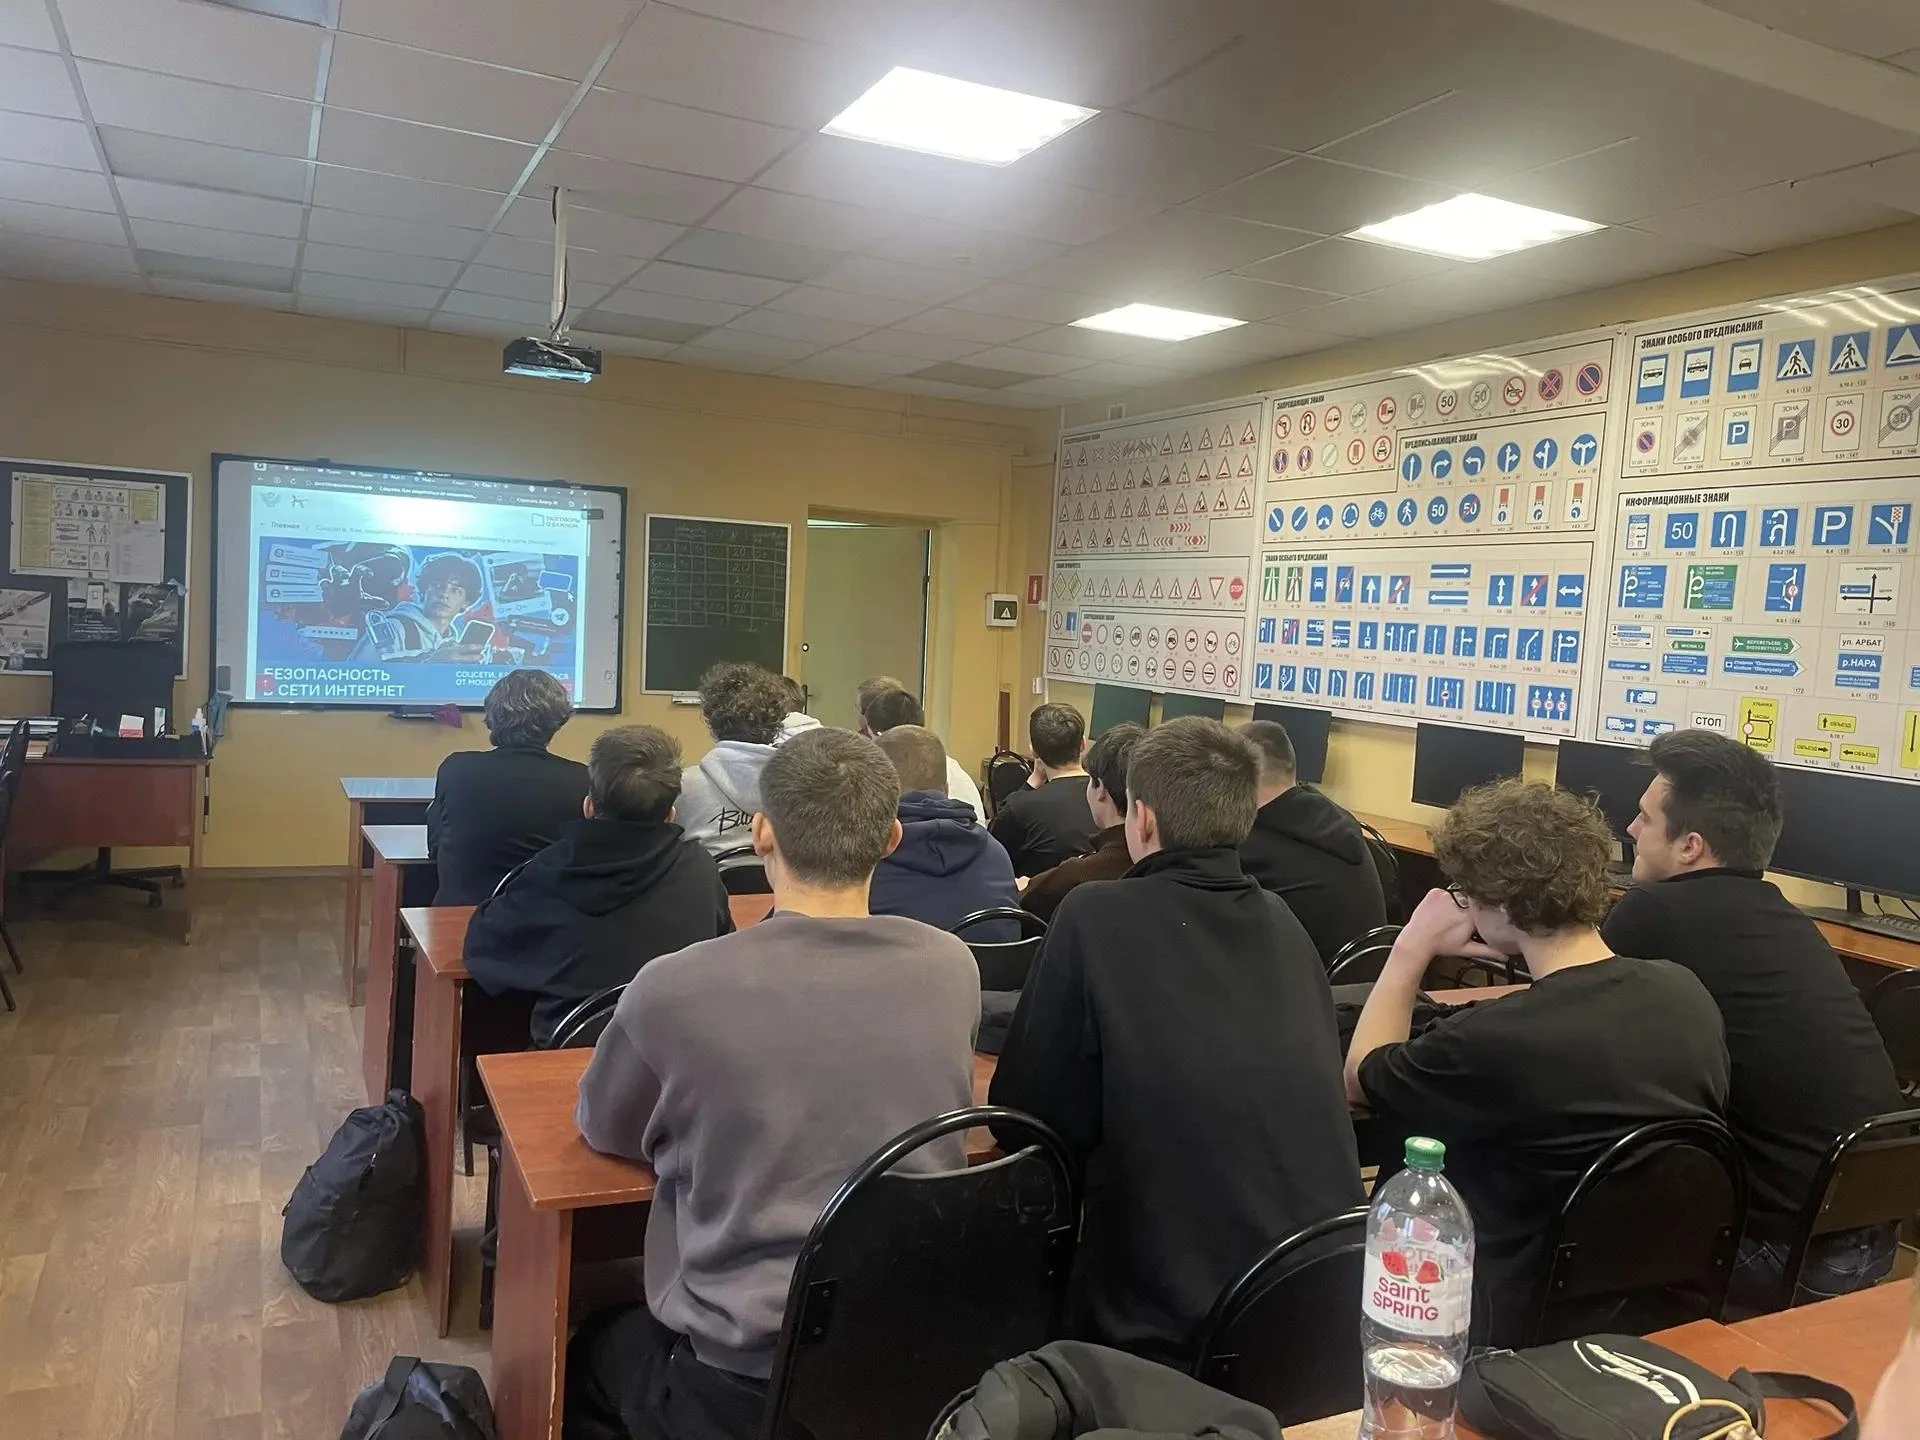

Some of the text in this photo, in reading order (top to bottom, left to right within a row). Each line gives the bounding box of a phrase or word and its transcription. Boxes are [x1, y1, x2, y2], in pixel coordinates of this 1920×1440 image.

[1641, 319, 1763, 350] ЗНАКИ ОСОБОГО ПРЕДПИСАНИЯ
[1441, 395, 1454, 408] 50
[1836, 418, 1850, 429] 30
[1731, 424, 1746, 443] P
[1625, 492, 1730, 507] ИНФОРМАЦИОННЫЕ ЗНАКИ
[1431, 504, 1445, 517] 50
[1671, 522, 1693, 540] 50
[1821, 511, 1847, 543] P
[1842, 639, 1882, 647] ул. АРБАТ
[1842, 658, 1877, 668] р.НАРА
[278, 685, 320, 696] СЕТИ
[325, 685, 405, 697] ИНТЕРНЕТ
[1695, 716, 1722, 728] СТОП
[1379, 1277, 1430, 1304] Saint
[1373, 1291, 1439, 1321] SPRING
